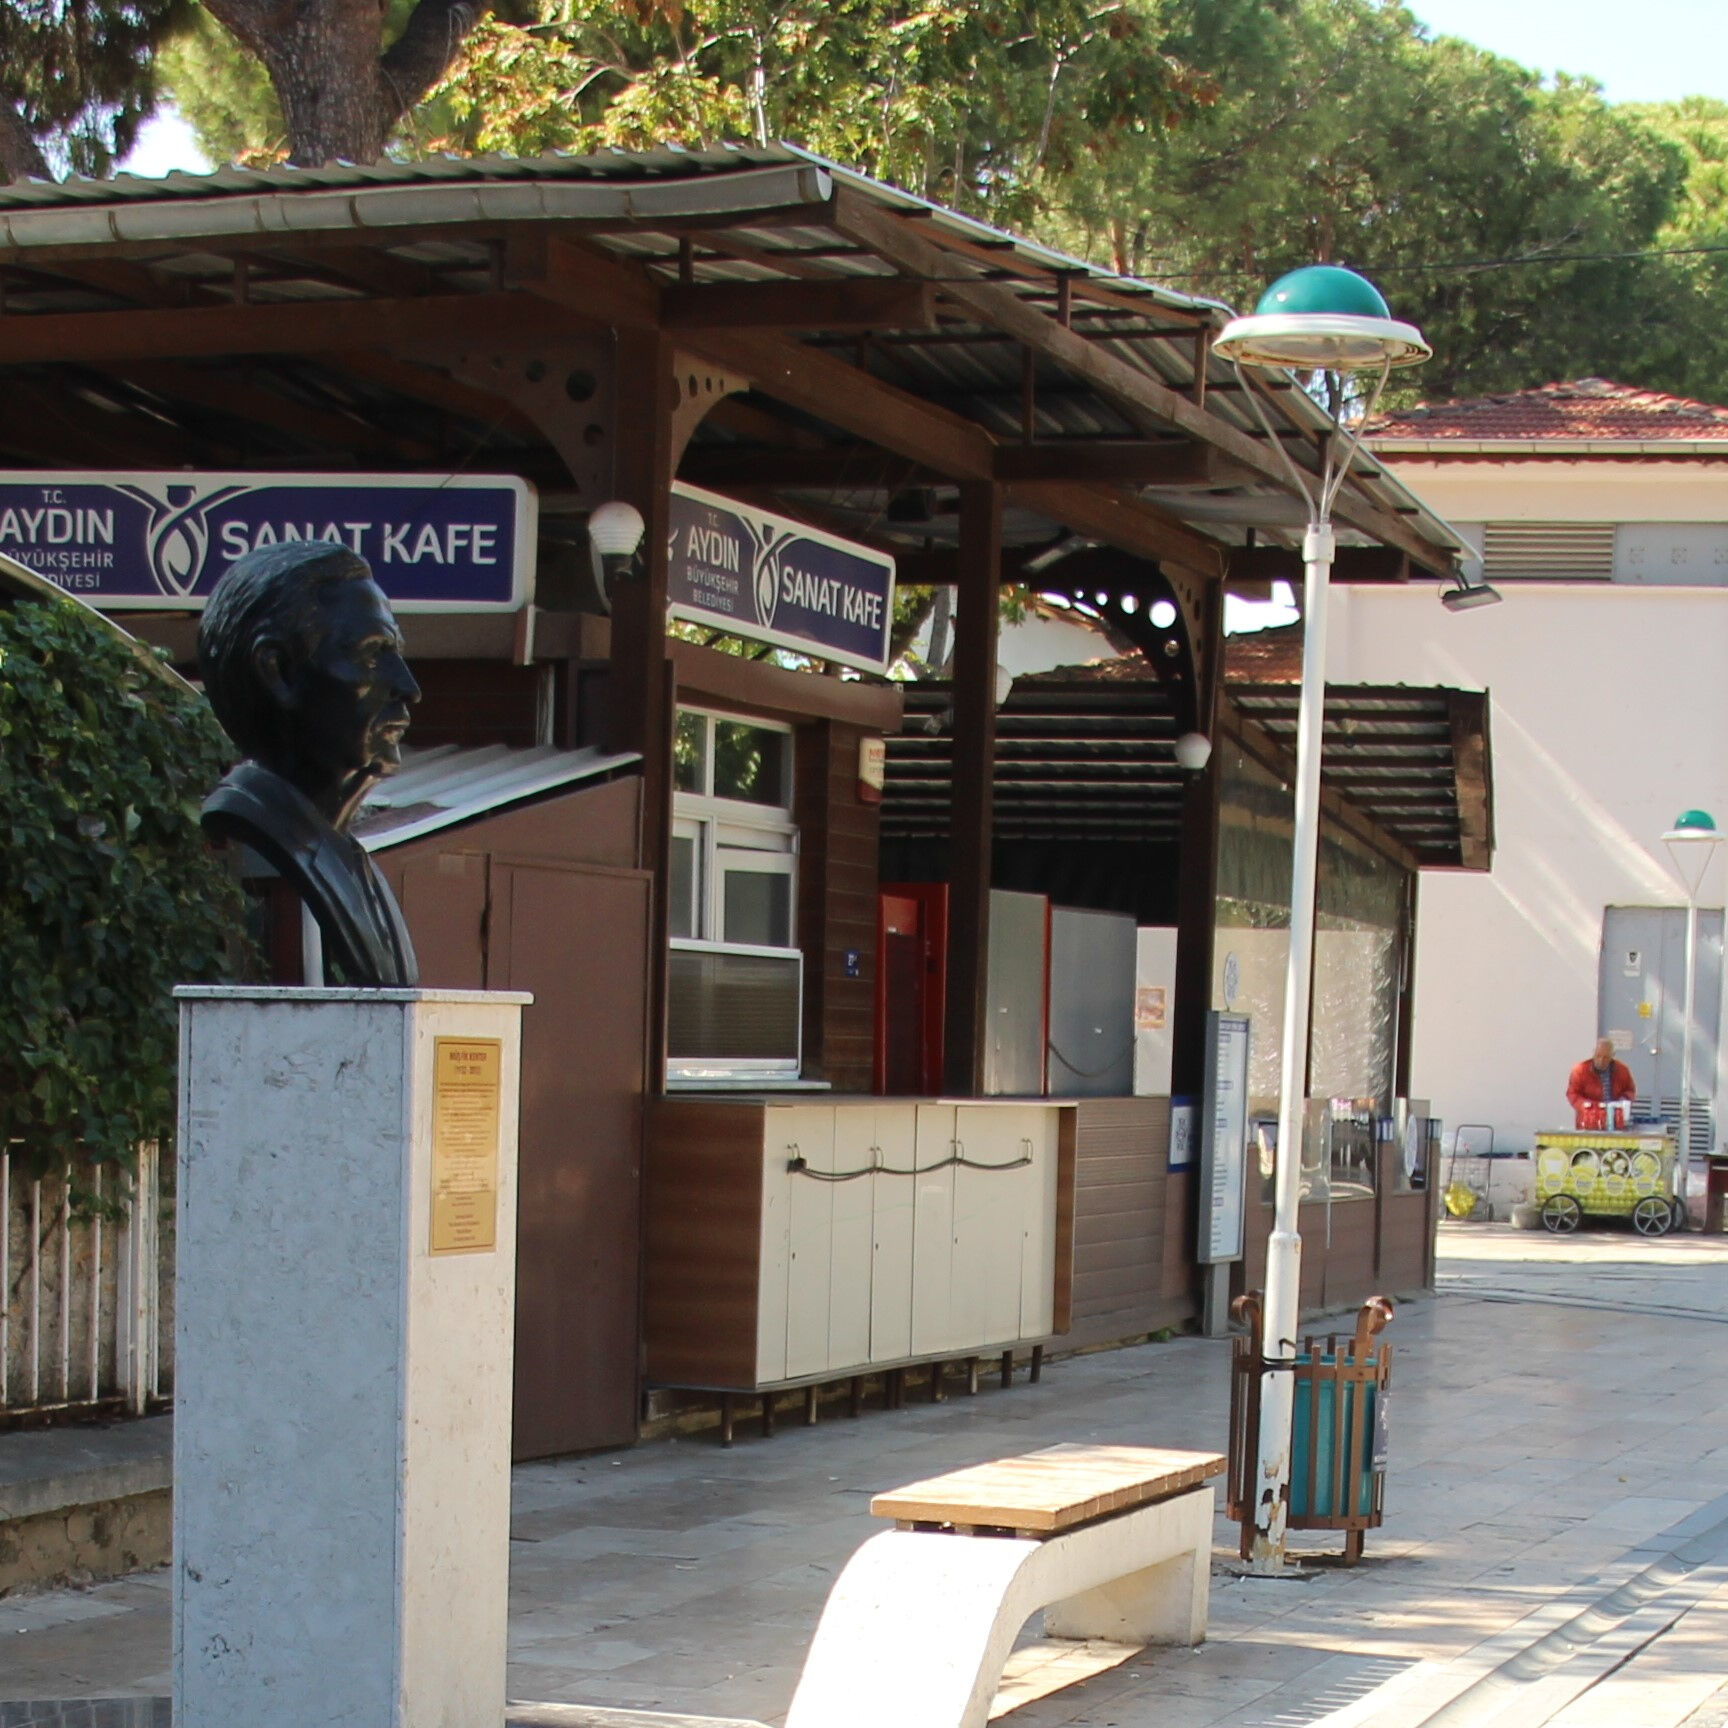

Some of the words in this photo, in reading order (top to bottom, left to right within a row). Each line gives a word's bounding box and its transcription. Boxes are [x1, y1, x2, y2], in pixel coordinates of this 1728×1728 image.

[41, 490, 67, 504] T.C.
[8, 549, 114, 571] ÜYÜKŞEHİR
[383, 522, 498, 565] KAFE
[686, 525, 740, 573] AYDIN
[781, 565, 842, 616] SANAT
[843, 586, 884, 631] KAFE
